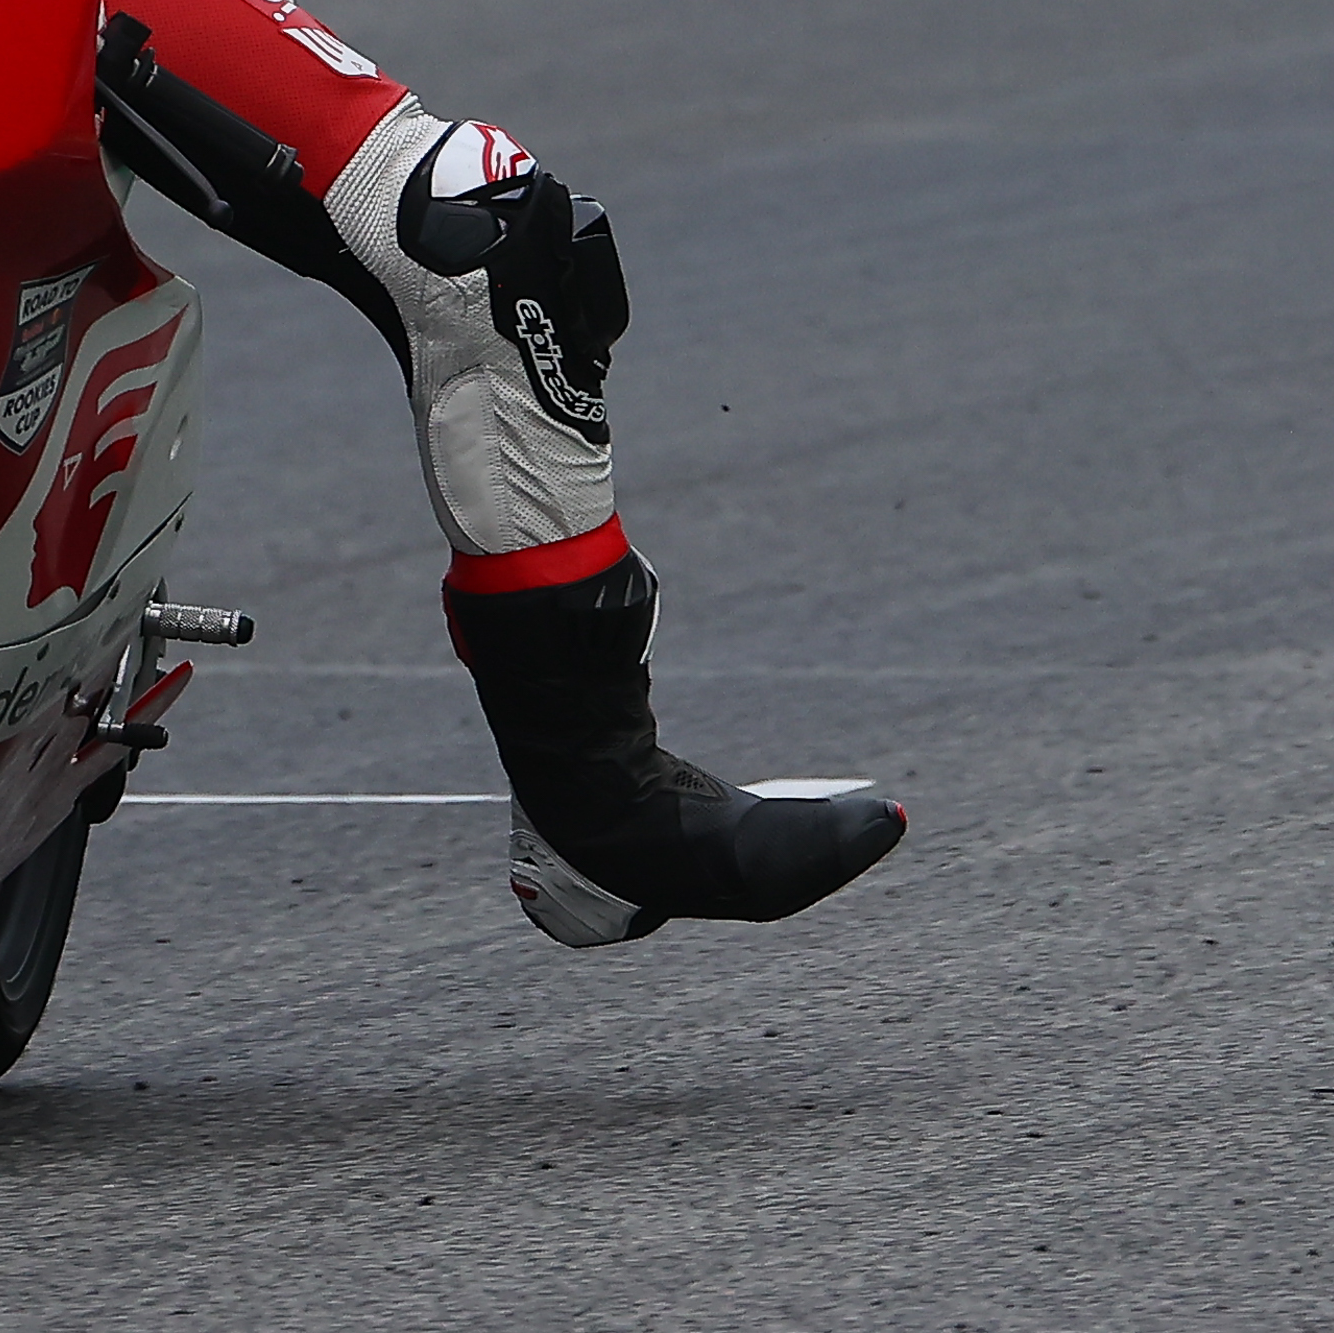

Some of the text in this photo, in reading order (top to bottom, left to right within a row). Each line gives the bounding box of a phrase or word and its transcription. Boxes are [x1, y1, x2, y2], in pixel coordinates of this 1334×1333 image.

[22, 277, 80, 318] ROAD TO
[3, 373, 57, 419] ROOKIES
[15, 407, 41, 435] CUP
